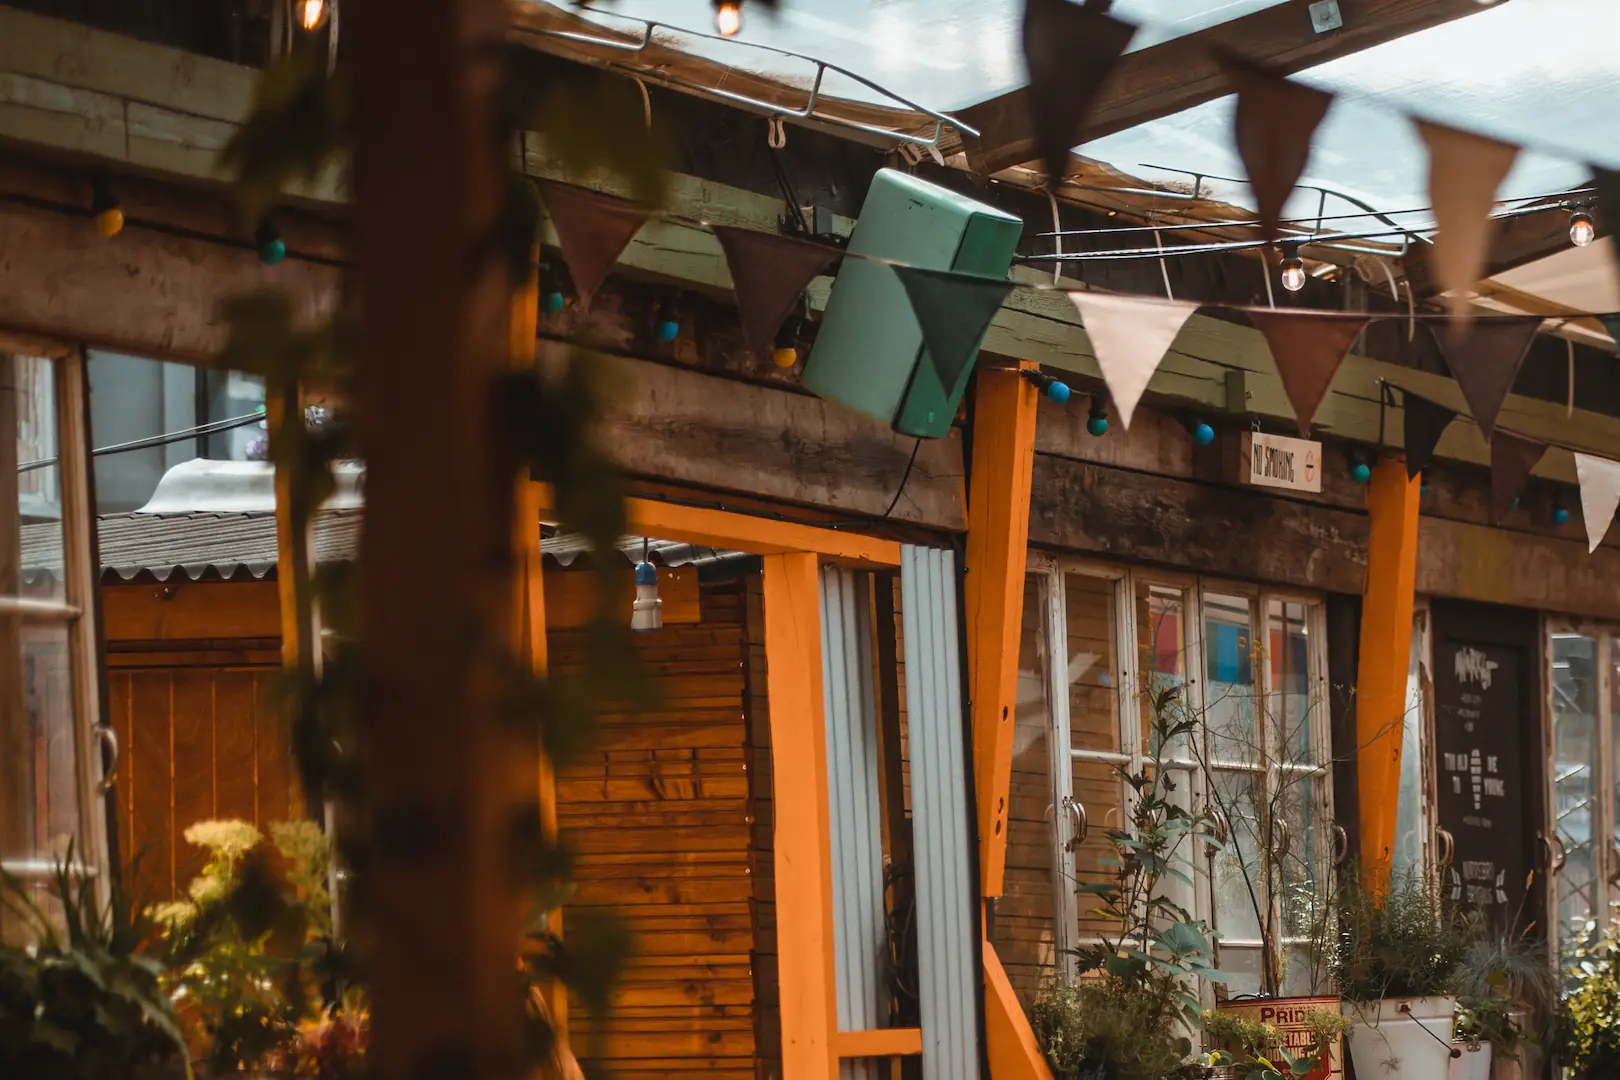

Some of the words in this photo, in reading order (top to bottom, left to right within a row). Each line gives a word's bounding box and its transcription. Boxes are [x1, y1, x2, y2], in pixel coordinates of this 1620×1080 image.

[1253, 443, 1263, 476] NO
[1265, 446, 1294, 483] SMOKING
[1260, 1007, 1316, 1023] PRID
